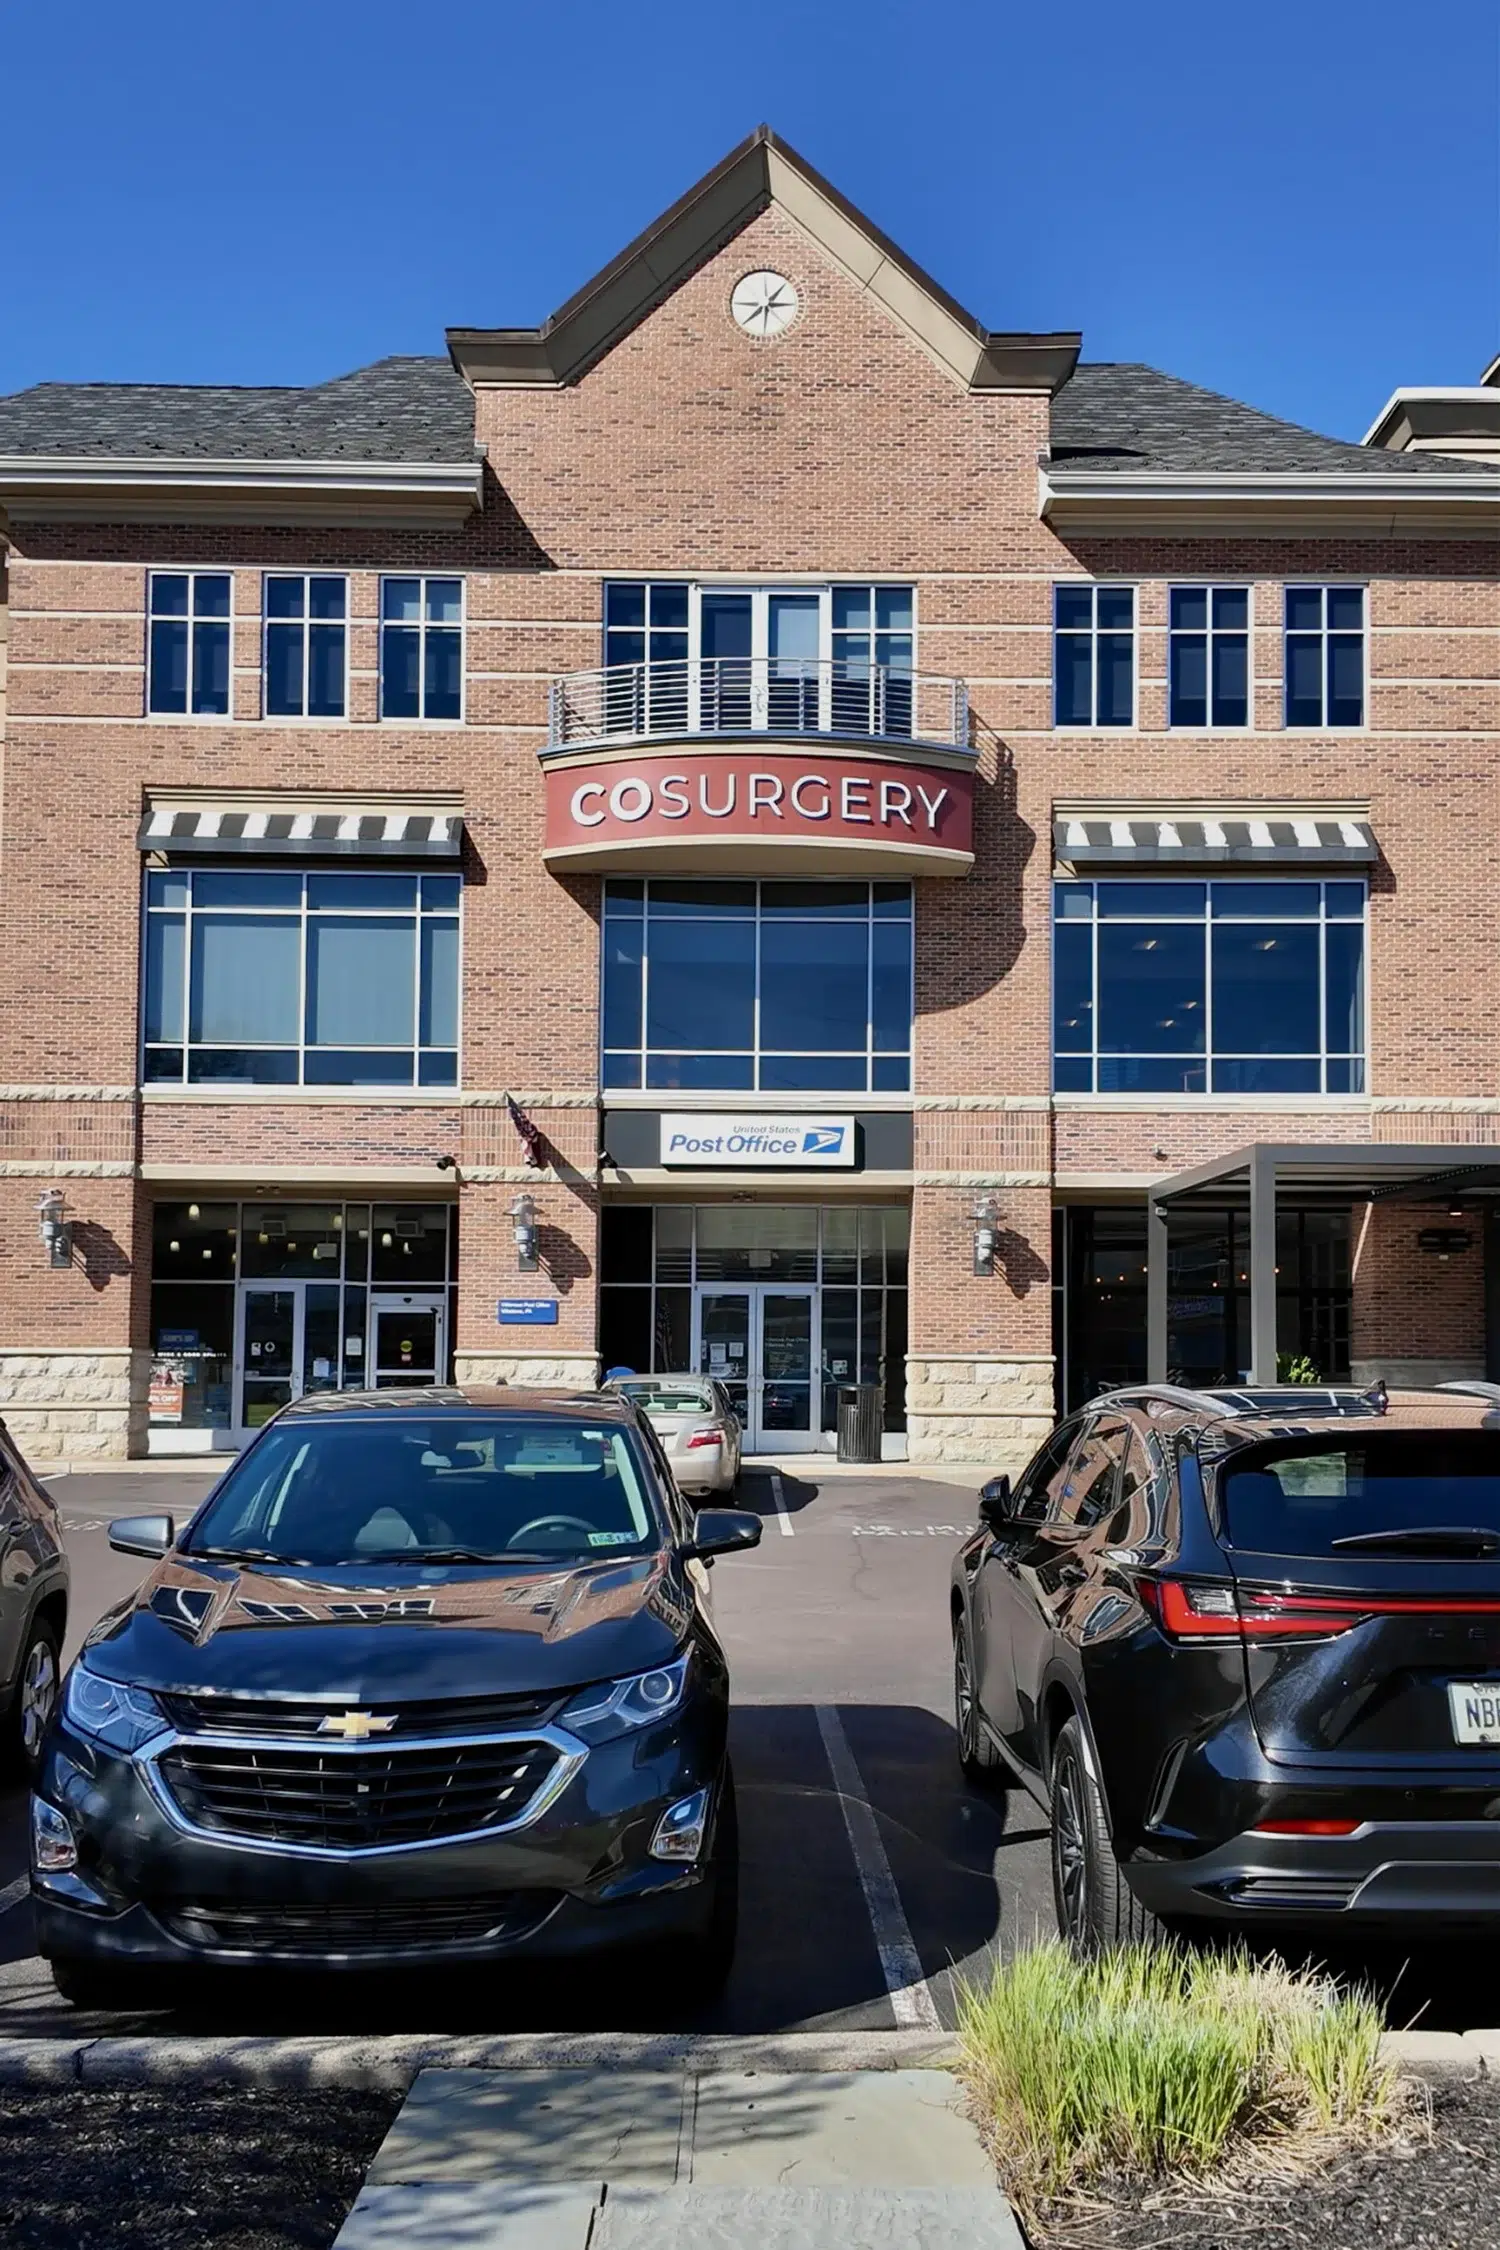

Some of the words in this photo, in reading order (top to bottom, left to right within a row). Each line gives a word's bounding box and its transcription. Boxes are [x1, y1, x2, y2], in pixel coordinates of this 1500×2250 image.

[570, 773, 949, 829] COSURGERY
[669, 1134, 724, 1153] Post
[726, 1134, 798, 1154] Office
